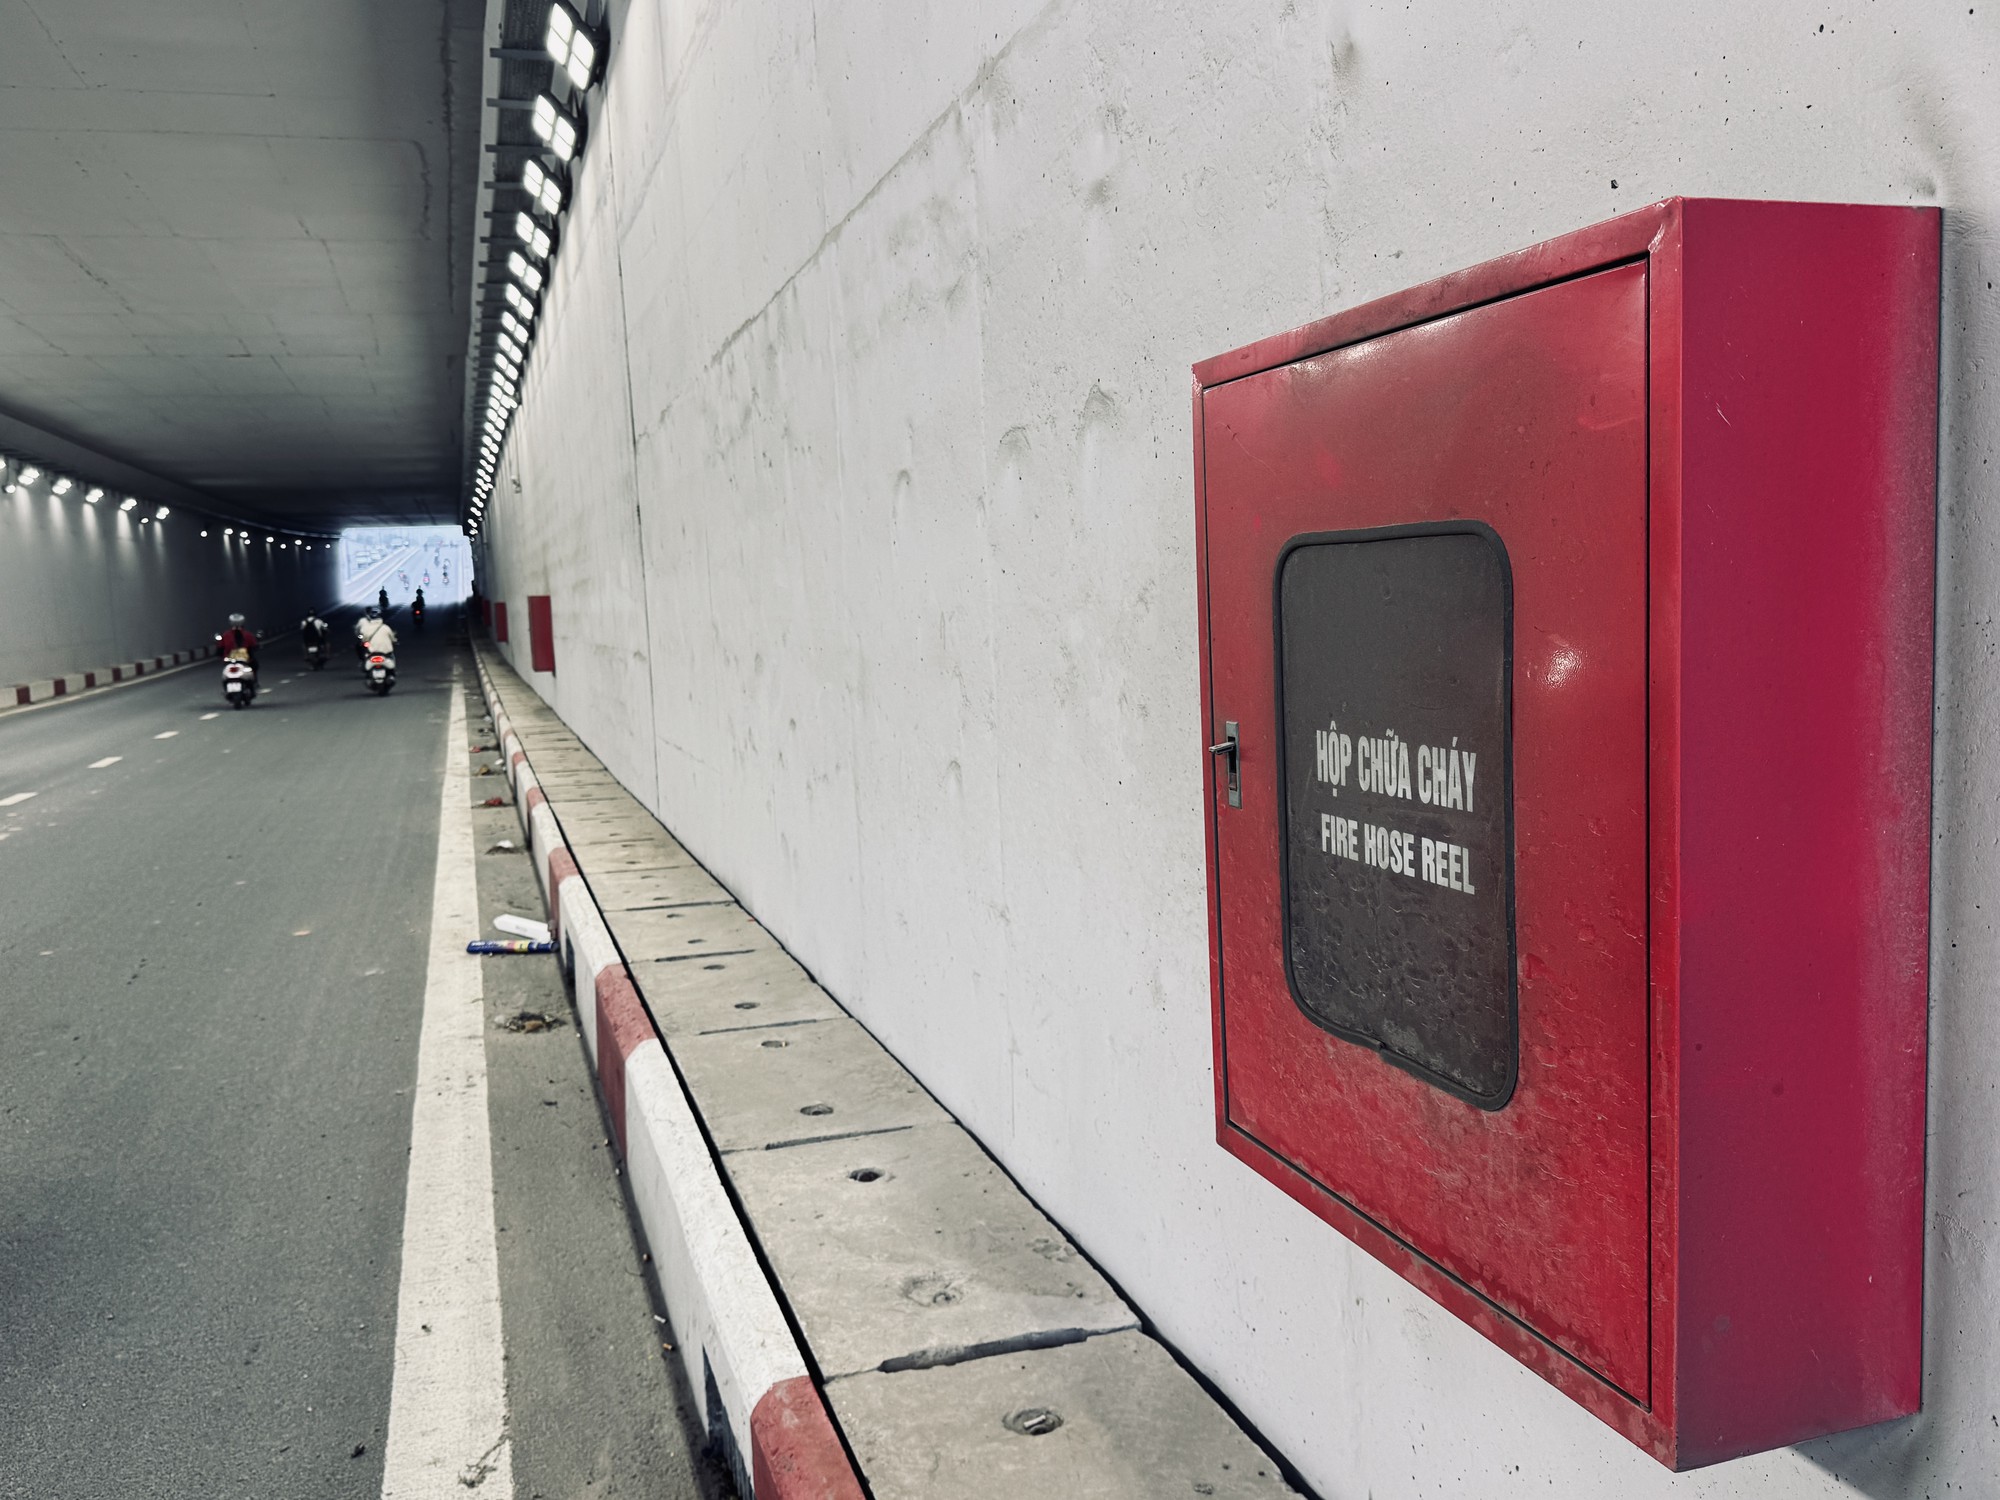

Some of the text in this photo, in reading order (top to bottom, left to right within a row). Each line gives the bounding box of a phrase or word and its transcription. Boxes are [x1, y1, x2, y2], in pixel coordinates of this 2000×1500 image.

[1315, 720, 1477, 813] HỘP CHỮA CHÁY
[1321, 812, 1475, 895] FIRE HOSE REEL
